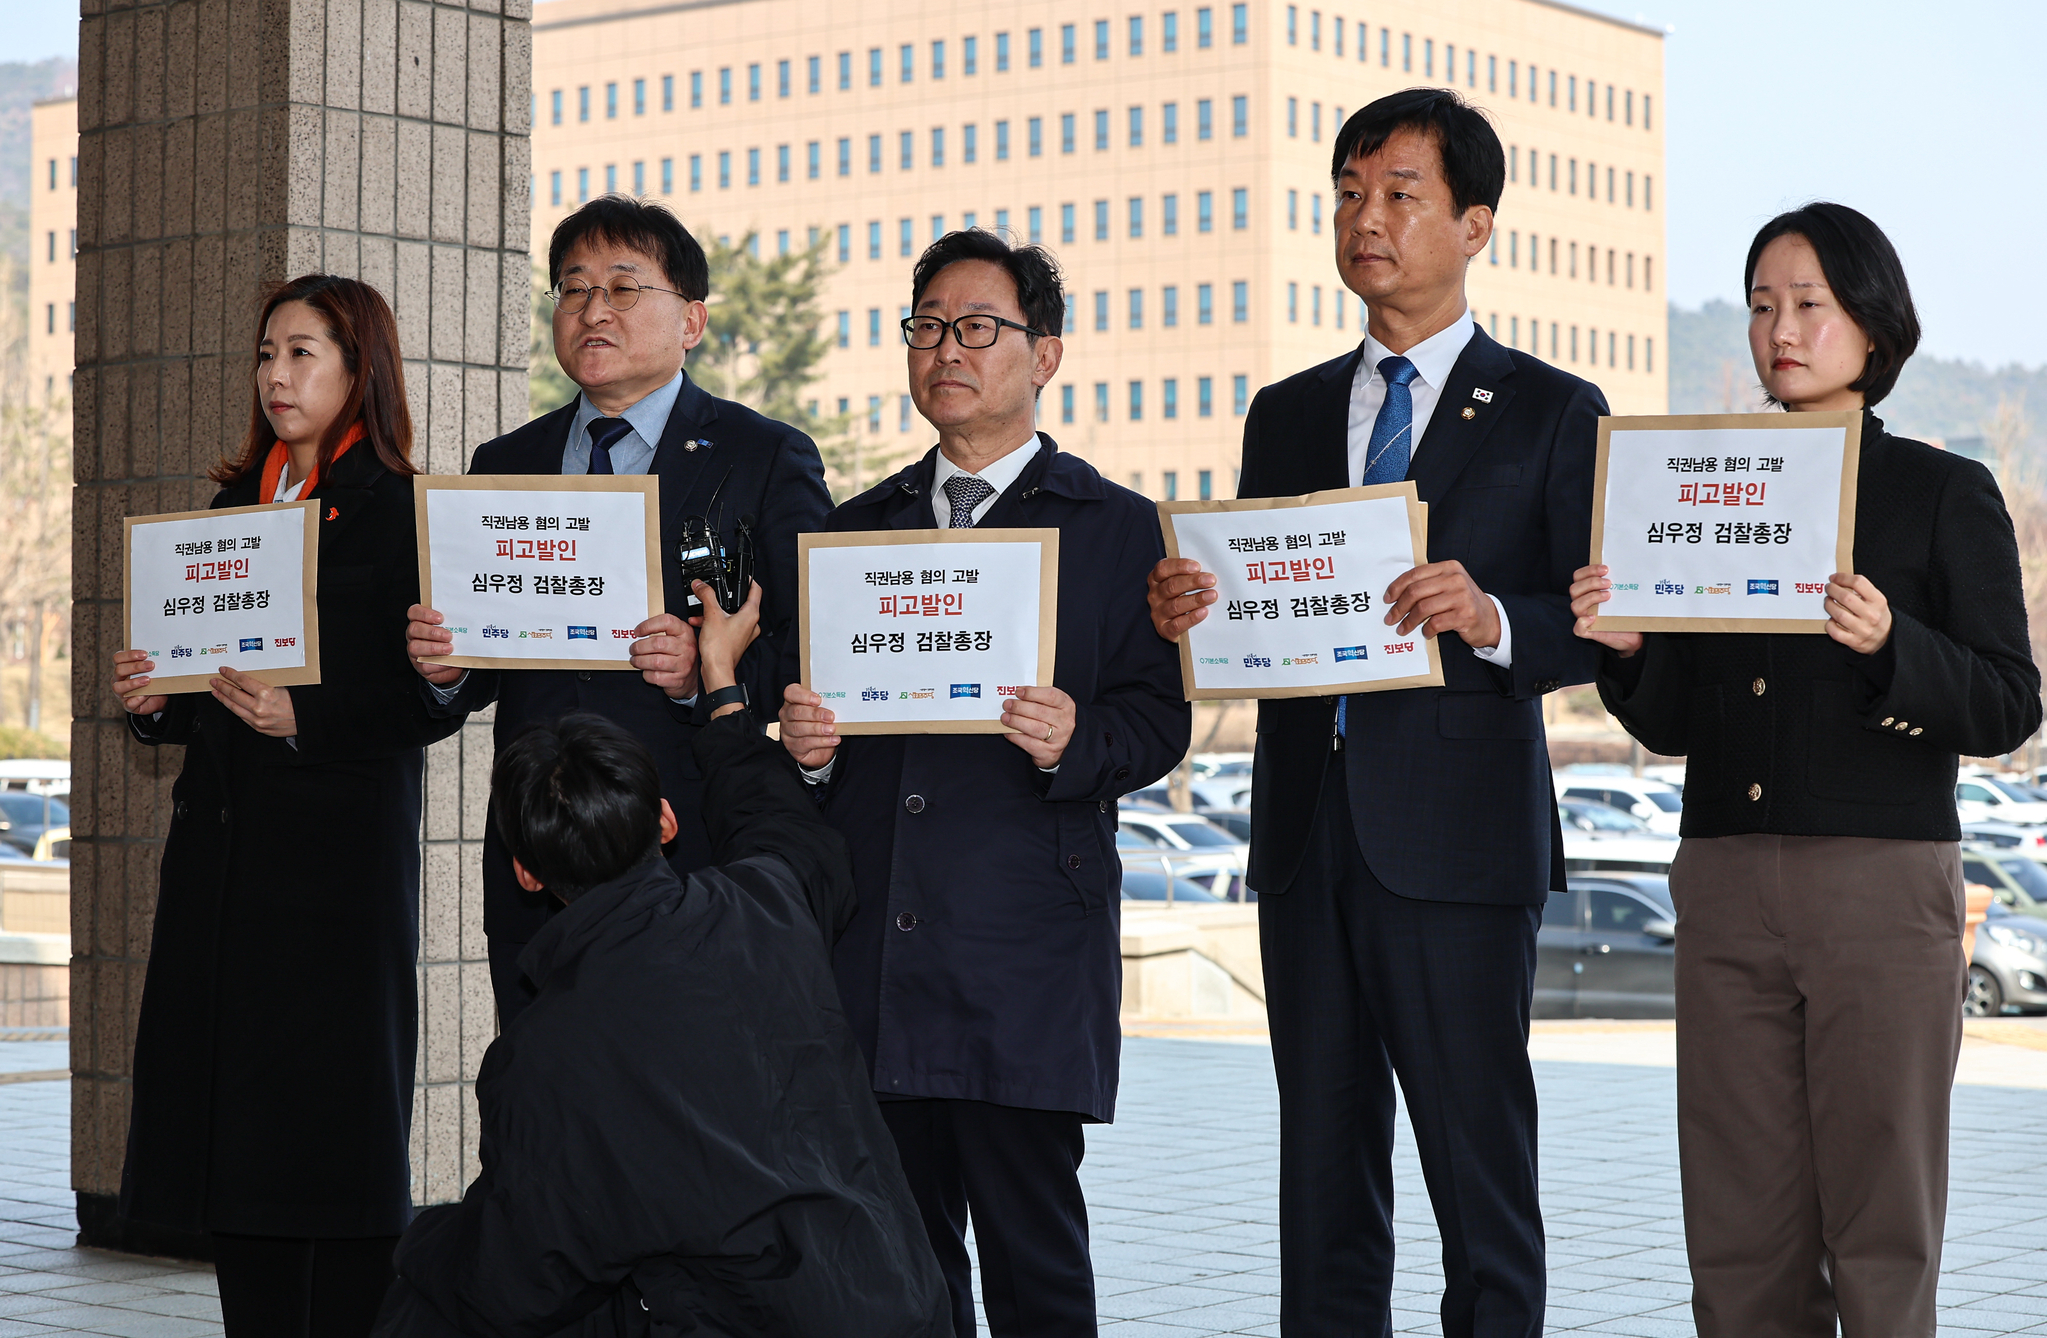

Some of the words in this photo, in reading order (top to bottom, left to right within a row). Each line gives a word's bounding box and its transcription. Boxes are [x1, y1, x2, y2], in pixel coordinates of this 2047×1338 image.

[1666, 457, 1718, 473] 직권남용
[1724, 457, 1750, 472] 혐의
[1756, 457, 1784, 472] 고발
[1678, 482, 1766, 506] 피고발인
[481, 515, 530, 530] 직권남용
[535, 516, 560, 531] 혐의
[565, 516, 591, 531] 고발
[1647, 521, 1703, 544] 심우정
[1714, 521, 1792, 545] 검찰총장
[175, 540, 213, 556] 직권남용
[217, 538, 237, 552] 혐의
[240, 535, 262, 550] 고발
[496, 538, 577, 562] 피고발인
[1228, 535, 1279, 553] 직권남용
[1284, 533, 1312, 551] 혐의
[1318, 530, 1346, 547] 고발
[185, 558, 249, 583] 피고발인
[864, 570, 914, 586] 직권남용
[920, 569, 946, 585] 혐의
[952, 568, 980, 584] 고발
[1246, 556, 1335, 584] 피고발인
[472, 573, 523, 593] 심우정
[533, 575, 605, 596] 검찰총장
[1655, 583, 1684, 595] 민주당
[1795, 583, 1825, 594] 진보당
[163, 596, 205, 616] 심우정
[213, 589, 270, 612] 검찰총장
[879, 592, 963, 618] 피고발인
[1226, 598, 1280, 620] 심우정
[1290, 591, 1371, 618] 검찰총장
[482, 628, 509, 638] 민주당
[851, 632, 905, 653] 심우정
[916, 630, 992, 652] 검찰총장
[171, 648, 193, 658] 민주당
[274, 637, 297, 648] 진보당
[1243, 657, 1271, 668] 민주당
[1383, 642, 1414, 655] 진보당
[862, 690, 889, 701] 민주당
[996, 686, 1018, 697] 진보
